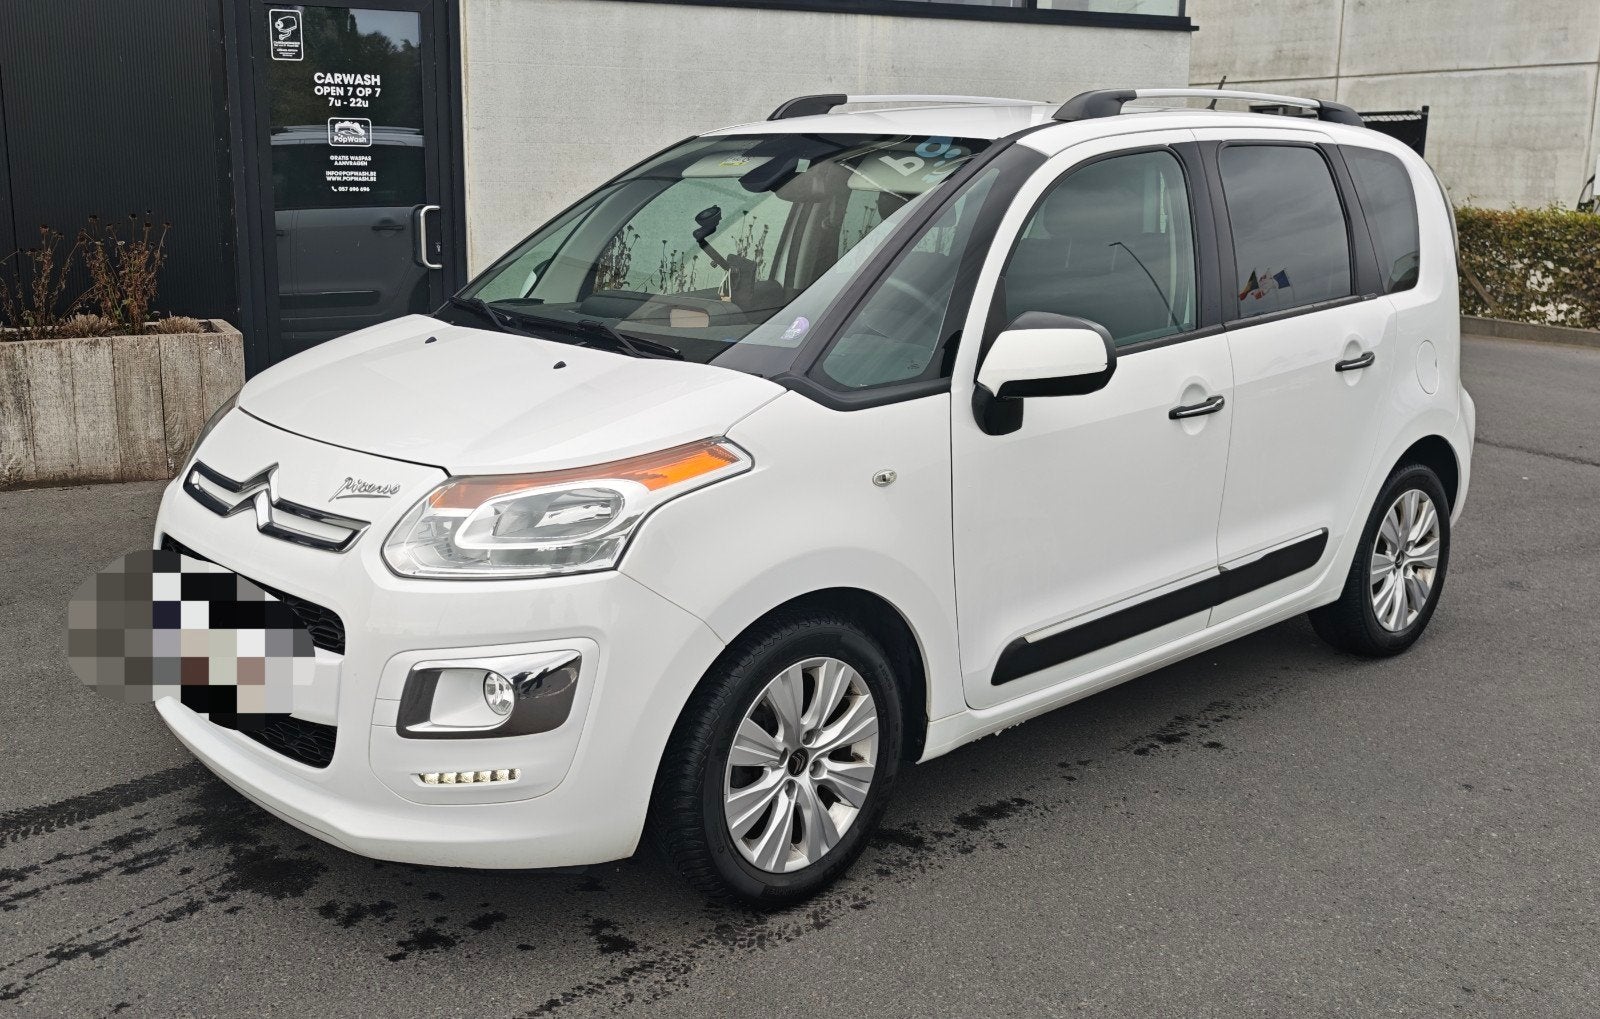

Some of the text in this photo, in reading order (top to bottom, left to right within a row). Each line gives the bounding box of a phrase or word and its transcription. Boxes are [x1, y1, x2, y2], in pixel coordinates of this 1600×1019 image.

[313, 72, 381, 86] CARWASH
[314, 85, 381, 98] OPEN 7 OP 7
[328, 96, 342, 107] 7u
[349, 97, 369, 108] 22u
[333, 135, 367, 143] PopWash
[328, 476, 401, 503] Picasso
